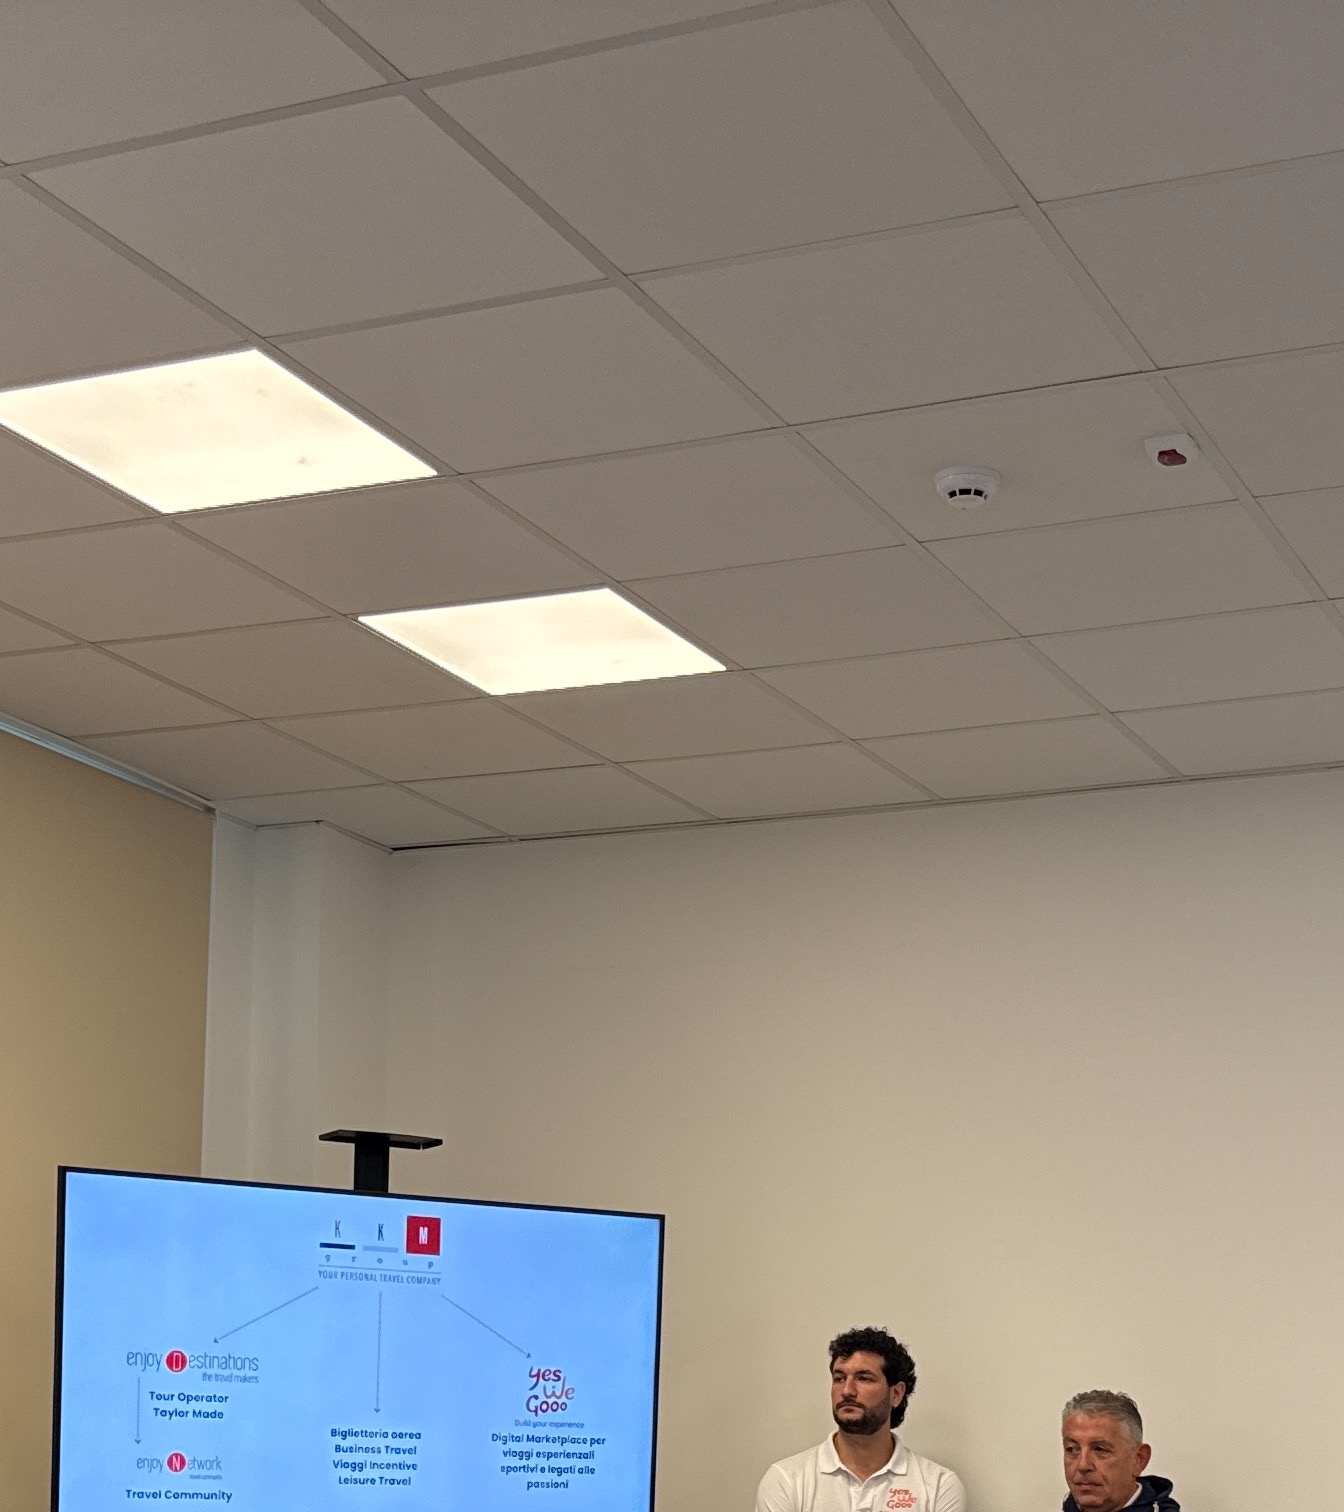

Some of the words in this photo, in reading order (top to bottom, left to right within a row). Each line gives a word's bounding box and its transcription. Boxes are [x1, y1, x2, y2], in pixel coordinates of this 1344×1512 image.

[318, 1270, 338, 1280] YOUR
[340, 1271, 378, 1283] PERSONAL
[379, 1274, 404, 1284] TRAVEL
[406, 1275, 441, 1286] COMPANY
[126, 1351, 163, 1372] enjoy
[149, 1391, 175, 1401] Tour
[177, 1392, 229, 1405] Operator
[153, 1407, 189, 1420] Taylor
[192, 1409, 224, 1419] Made
[331, 1428, 389, 1440] Biglietteria
[391, 1431, 422, 1440] aerea
[491, 1432, 524, 1445] Digital
[526, 1434, 588, 1446] Marketplace
[589, 1437, 606, 1447] per
[334, 1444, 382, 1454] Business
[384, 1445, 417, 1455] Travel
[502, 1448, 534, 1460] viaggi
[136, 1457, 164, 1473] enjoy
[332, 1459, 368, 1472] Viaggi
[369, 1460, 418, 1471] Incentive
[500, 1463, 538, 1475] sportivi
[539, 1466, 546, 1474] e
[547, 1464, 576, 1477] legati
[577, 1465, 596, 1475] alle
[338, 1475, 376, 1485] Leisure
[378, 1476, 412, 1486] Travel
[526, 1479, 569, 1491] passioni
[125, 1489, 162, 1500] Travel
[164, 1490, 233, 1503] Community
